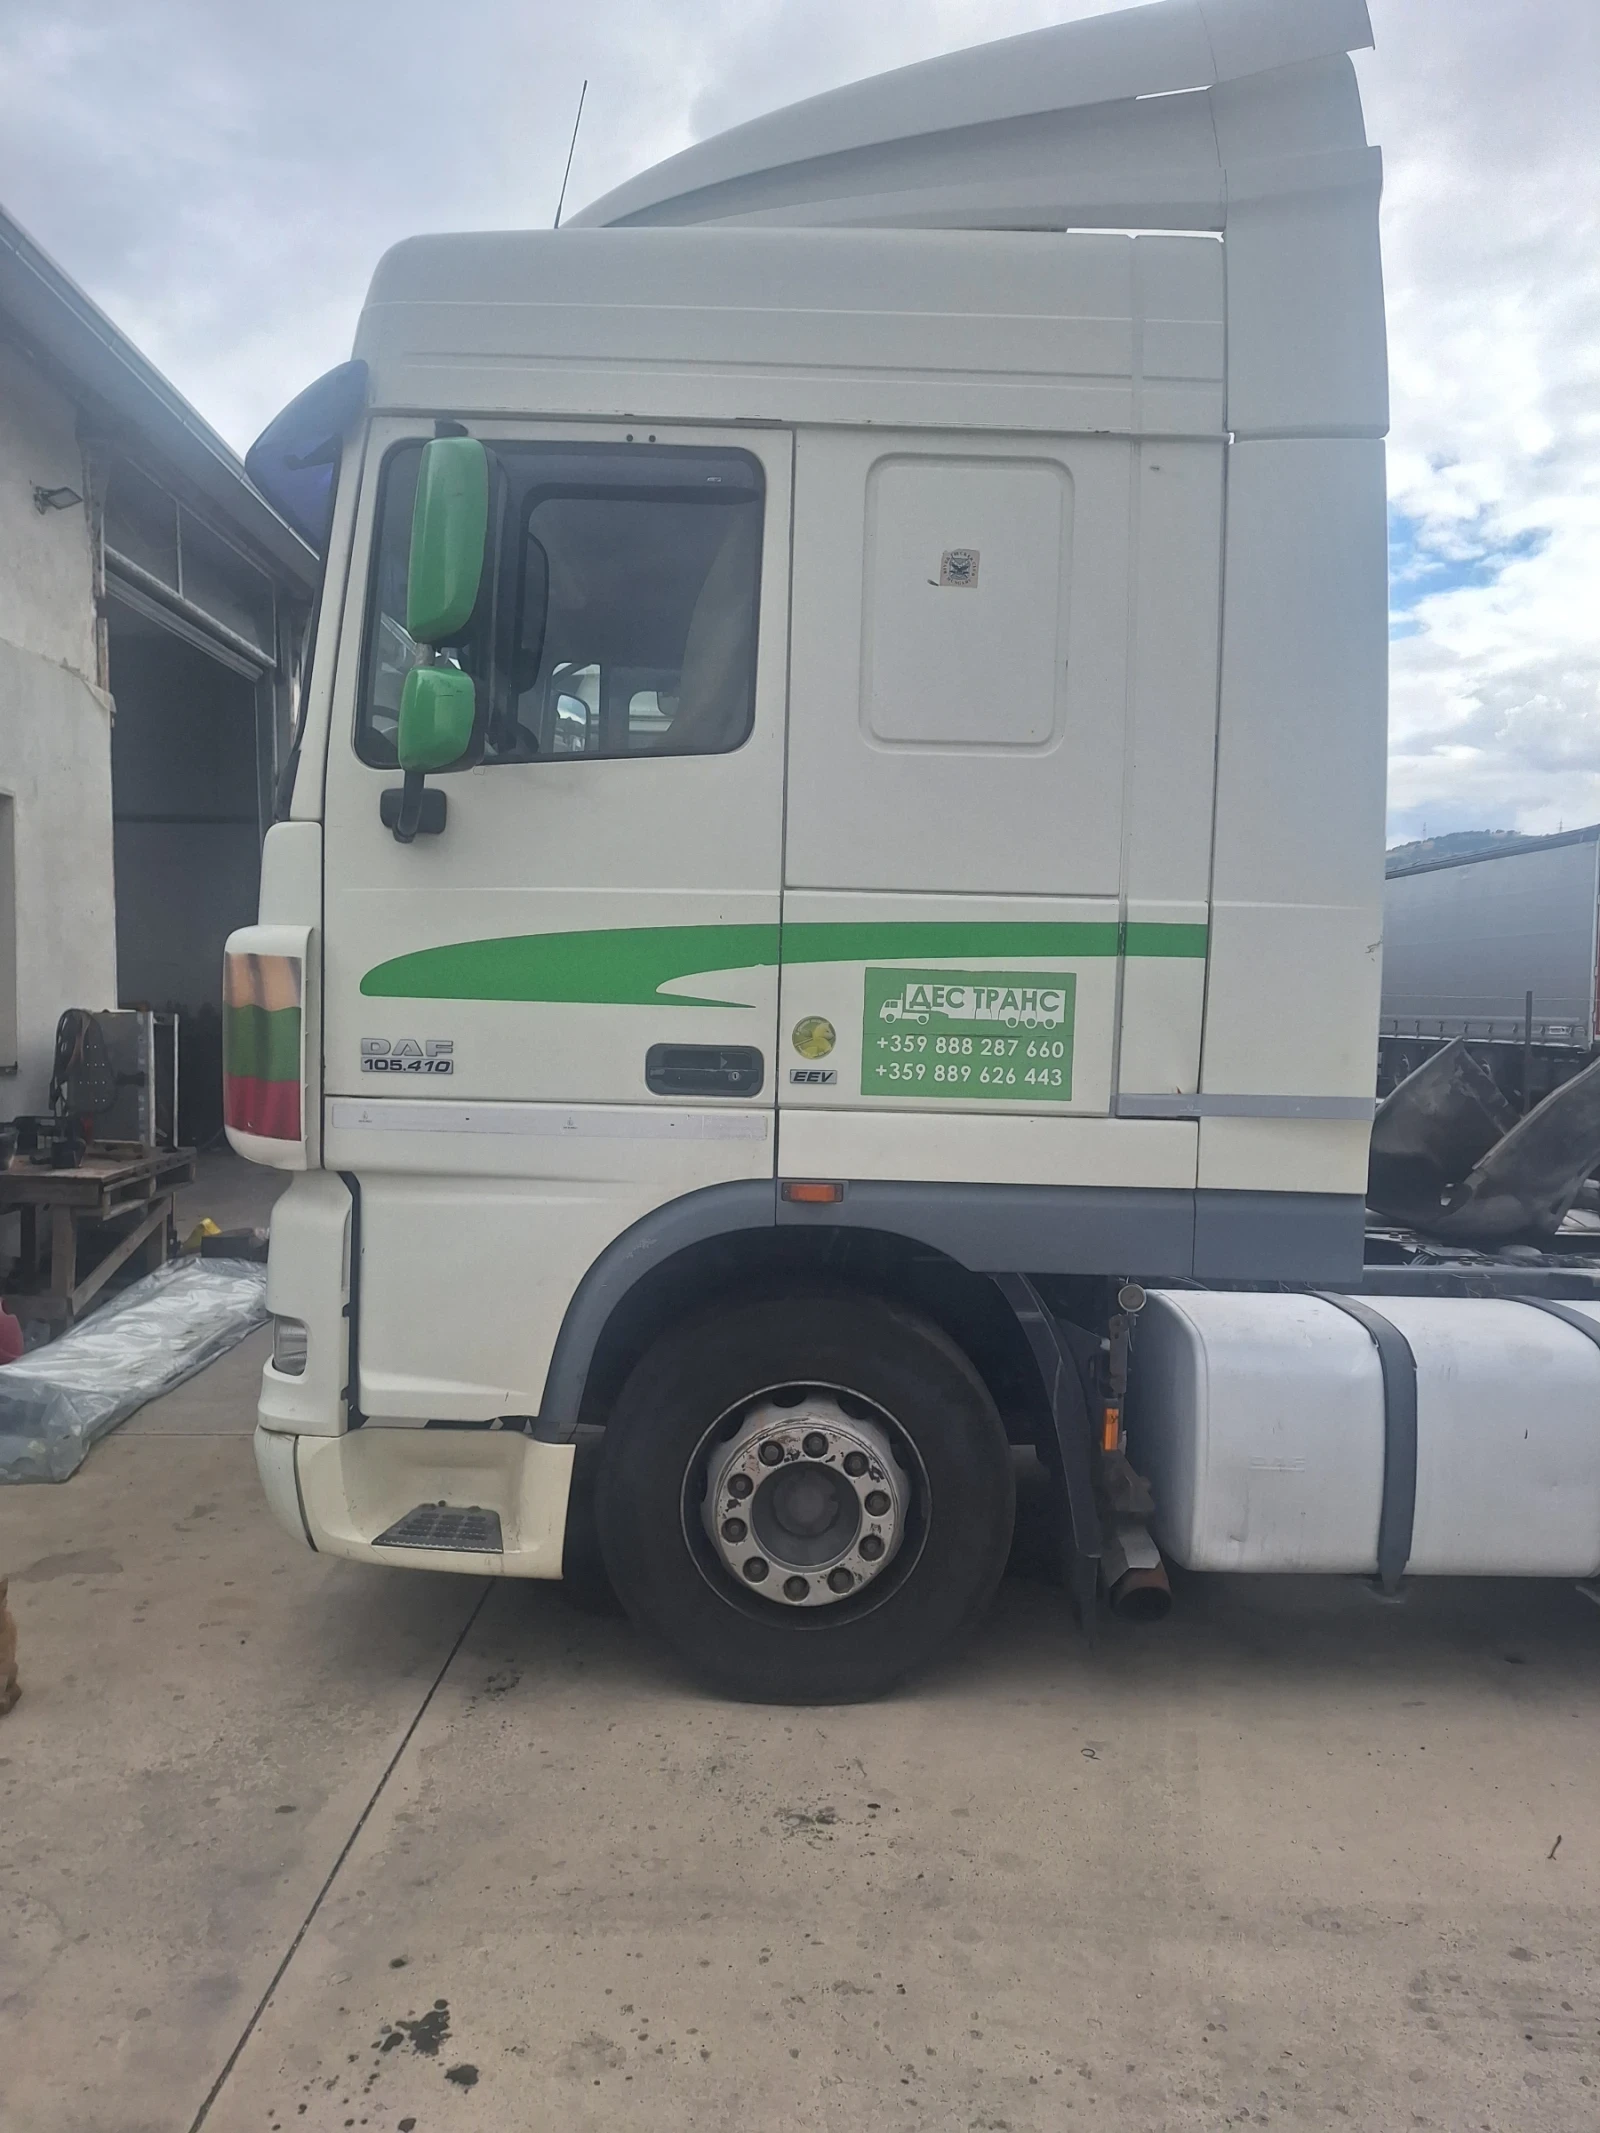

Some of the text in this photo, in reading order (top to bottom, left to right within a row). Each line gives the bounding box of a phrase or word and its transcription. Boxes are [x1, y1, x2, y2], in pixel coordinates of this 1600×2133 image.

[909, 986, 1060, 1012] ДЕС ТРАНС
[361, 1038, 453, 1057] DAF
[877, 1035, 1064, 1058] +359 888 287 660
[364, 1059, 451, 1072] 105.410
[875, 1063, 1062, 1086] +359 889 626 443
[794, 1071, 833, 1082] EEV
